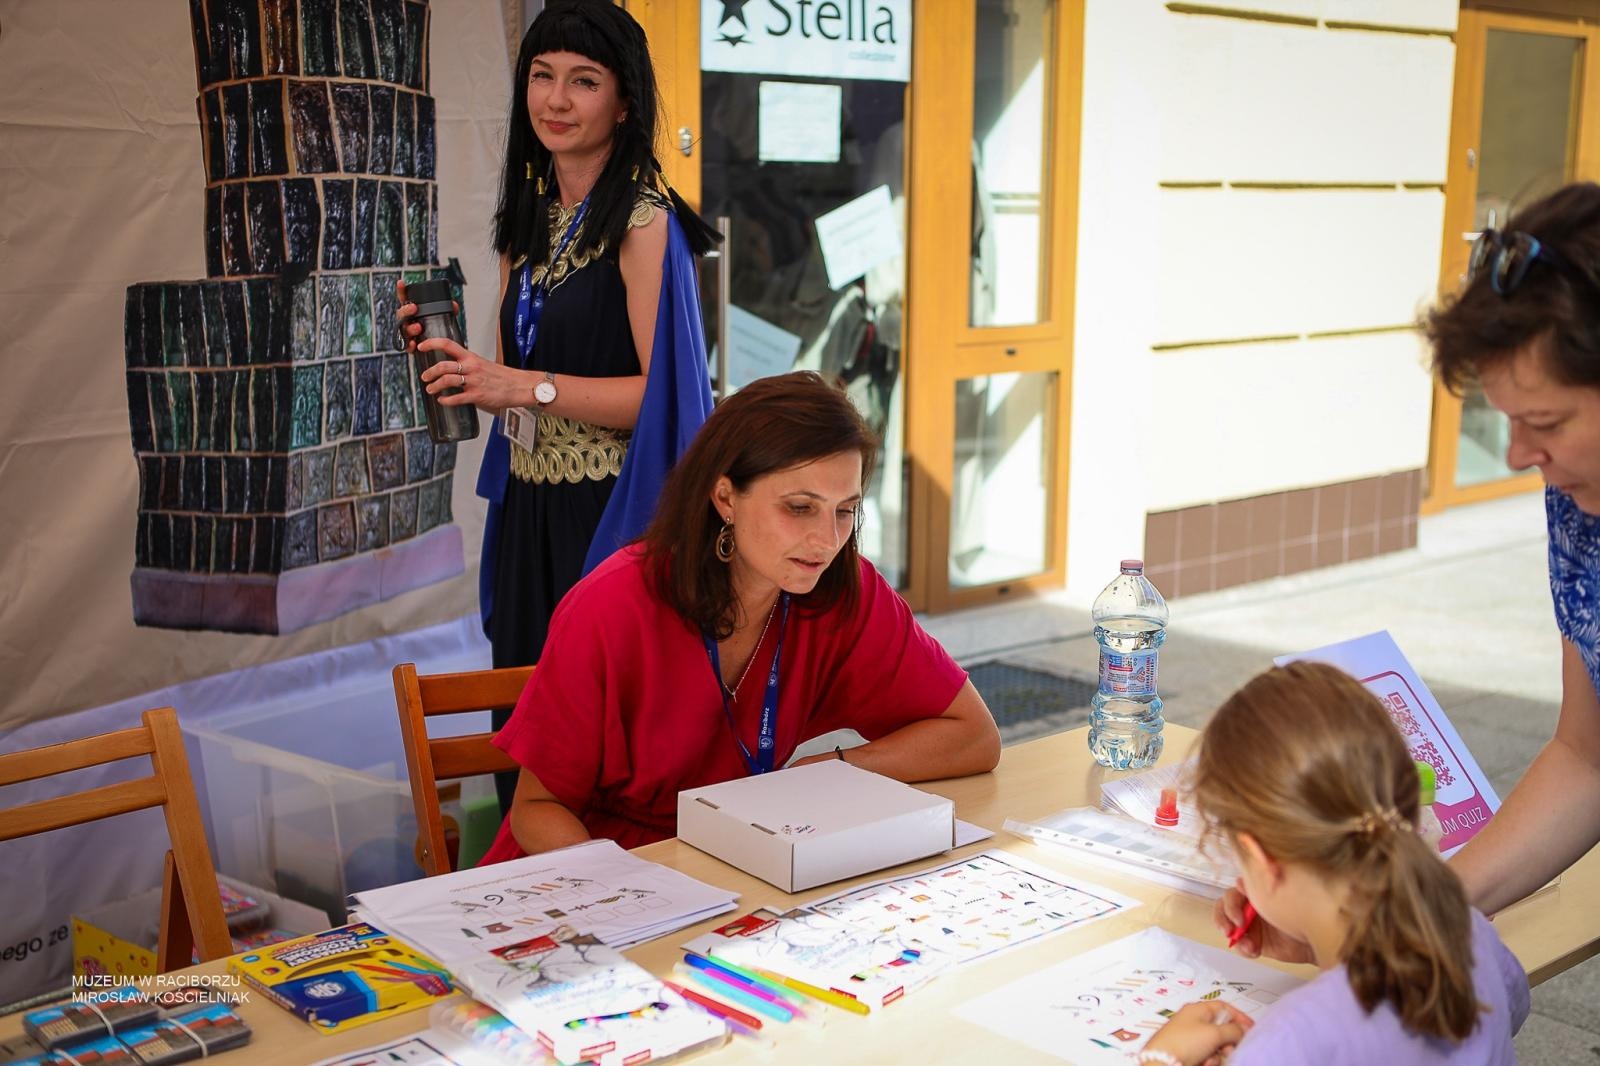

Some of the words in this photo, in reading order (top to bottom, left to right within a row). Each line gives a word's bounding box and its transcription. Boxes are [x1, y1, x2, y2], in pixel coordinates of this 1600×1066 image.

[766, 0, 896, 44] Stella
[1457, 806, 1487, 829] QUIZ
[0, 935, 43, 962] ego
[48, 924, 69, 947] ze
